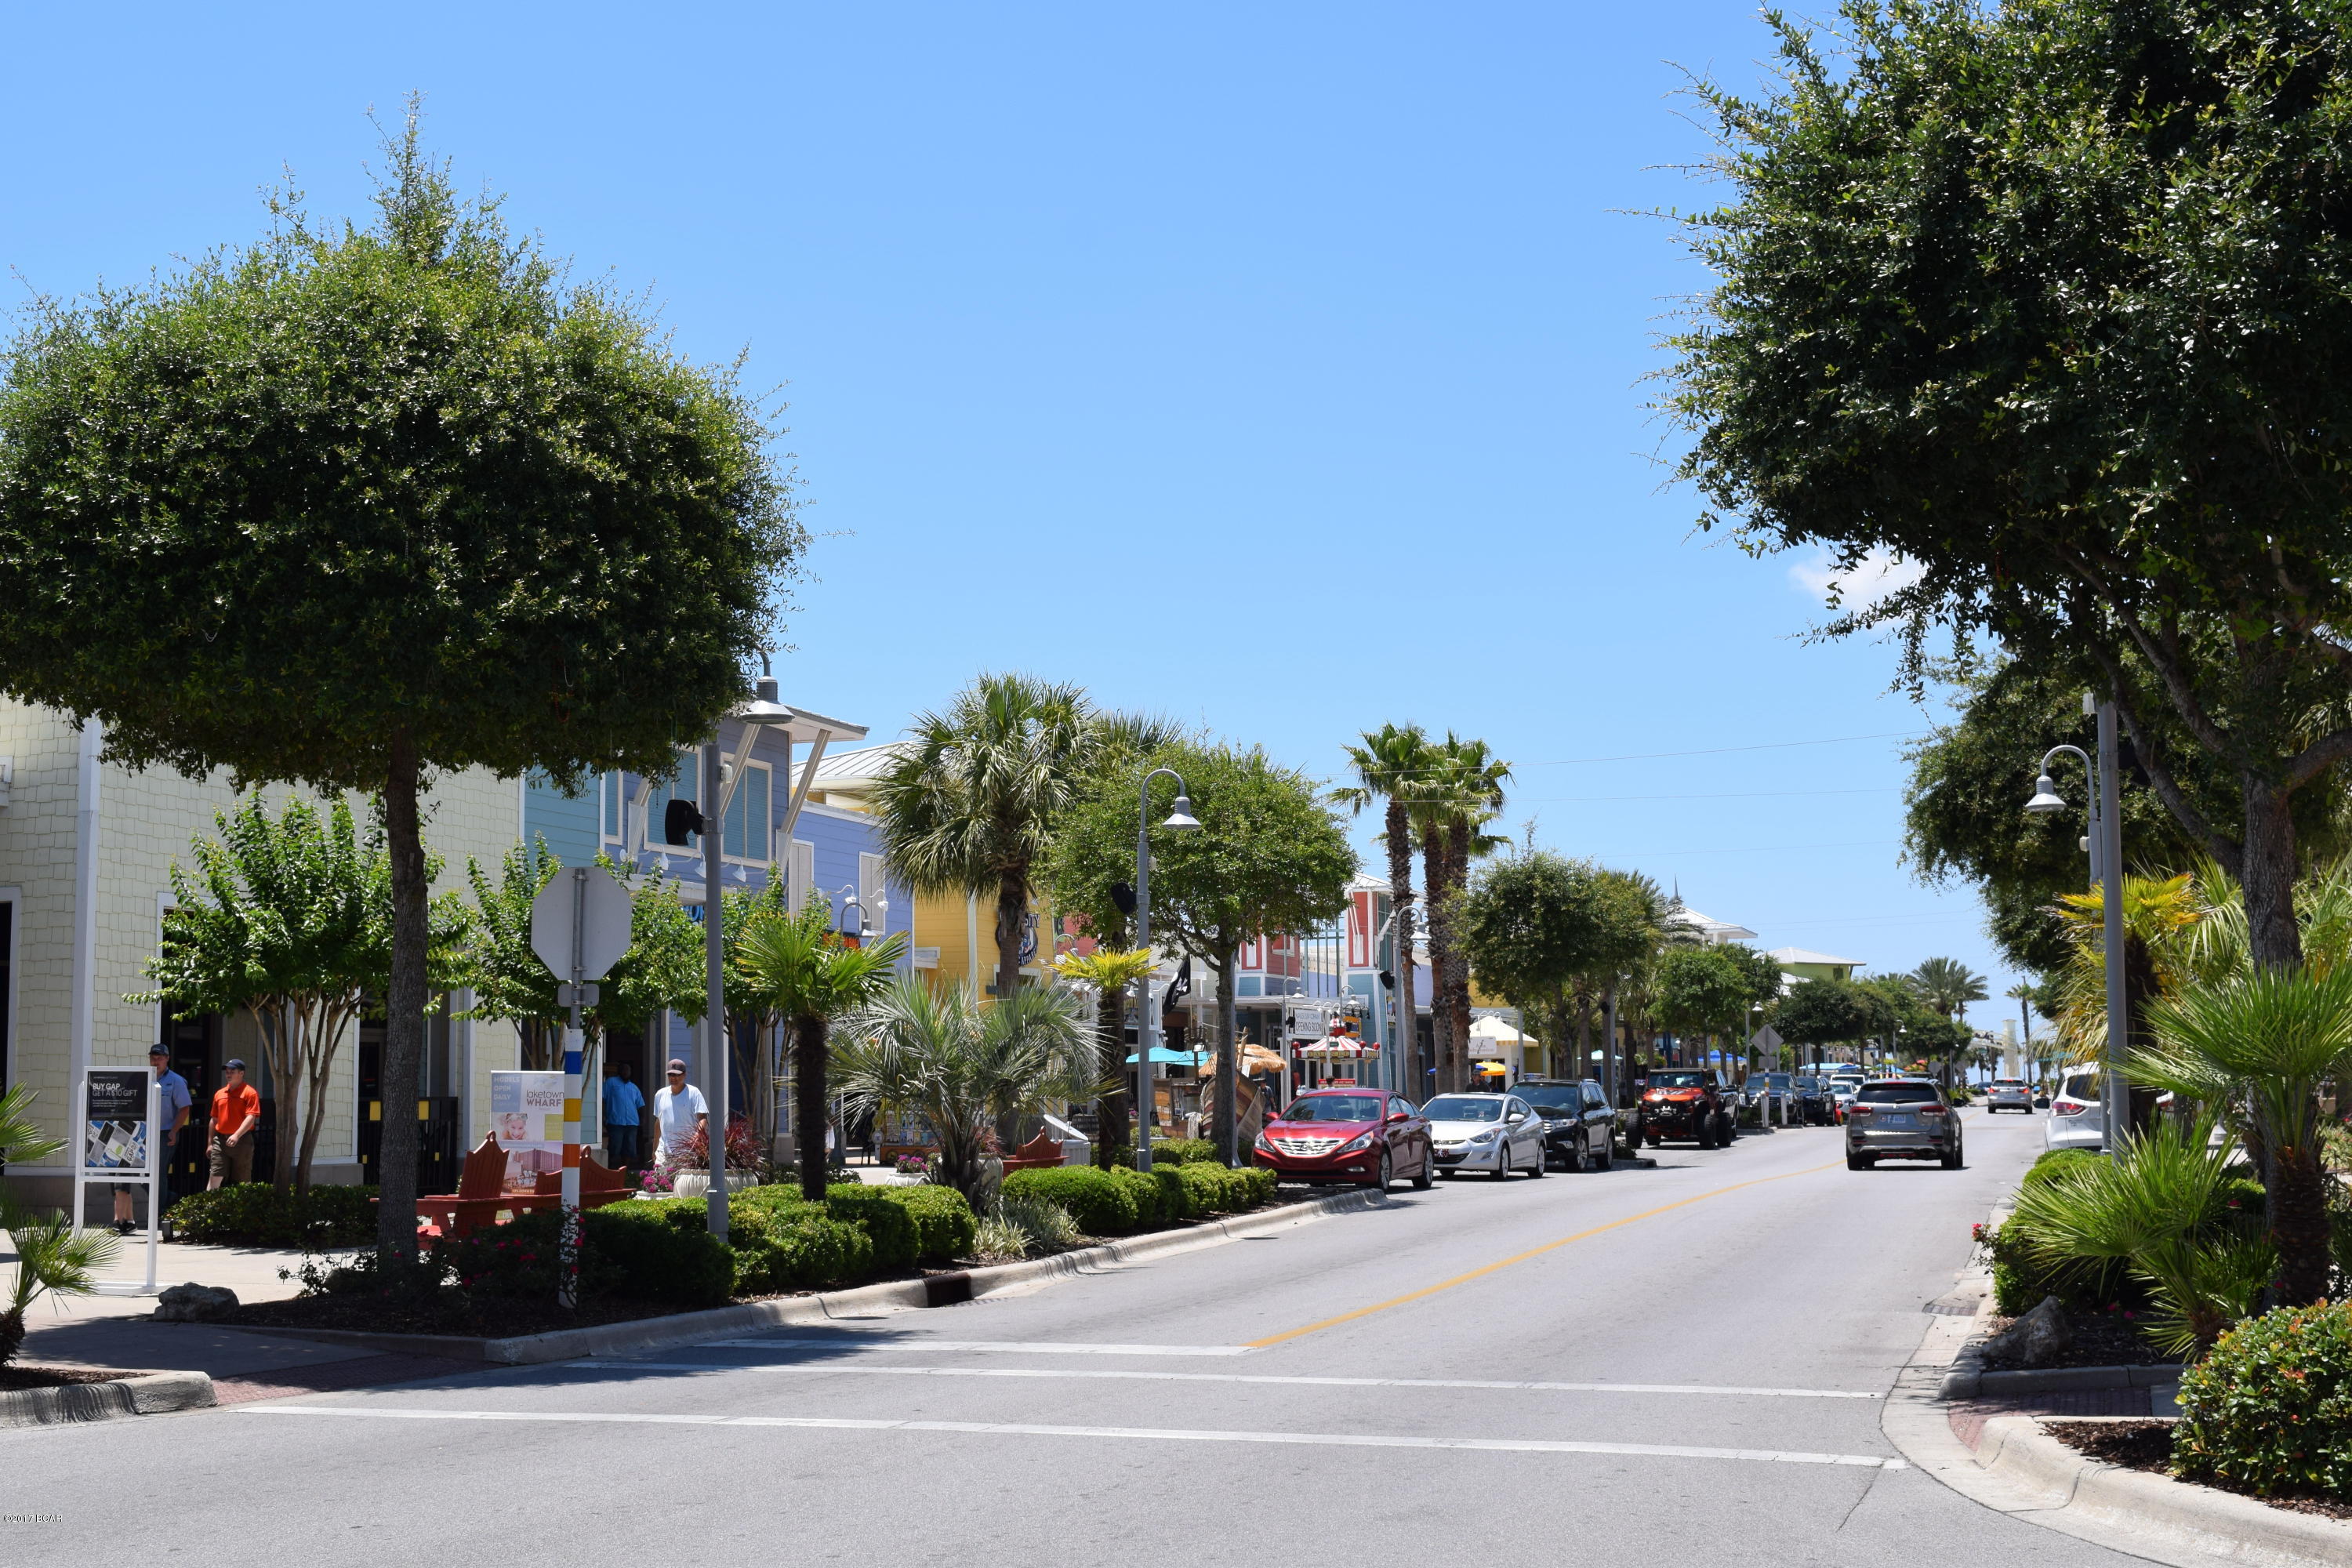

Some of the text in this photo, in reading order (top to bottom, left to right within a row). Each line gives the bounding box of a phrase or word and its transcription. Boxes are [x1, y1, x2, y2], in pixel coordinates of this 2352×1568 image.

[1296, 1022, 1322, 1032] OPENING SOON
[526, 1090, 564, 1098] laketown
[526, 1098, 562, 1107] WHARF
